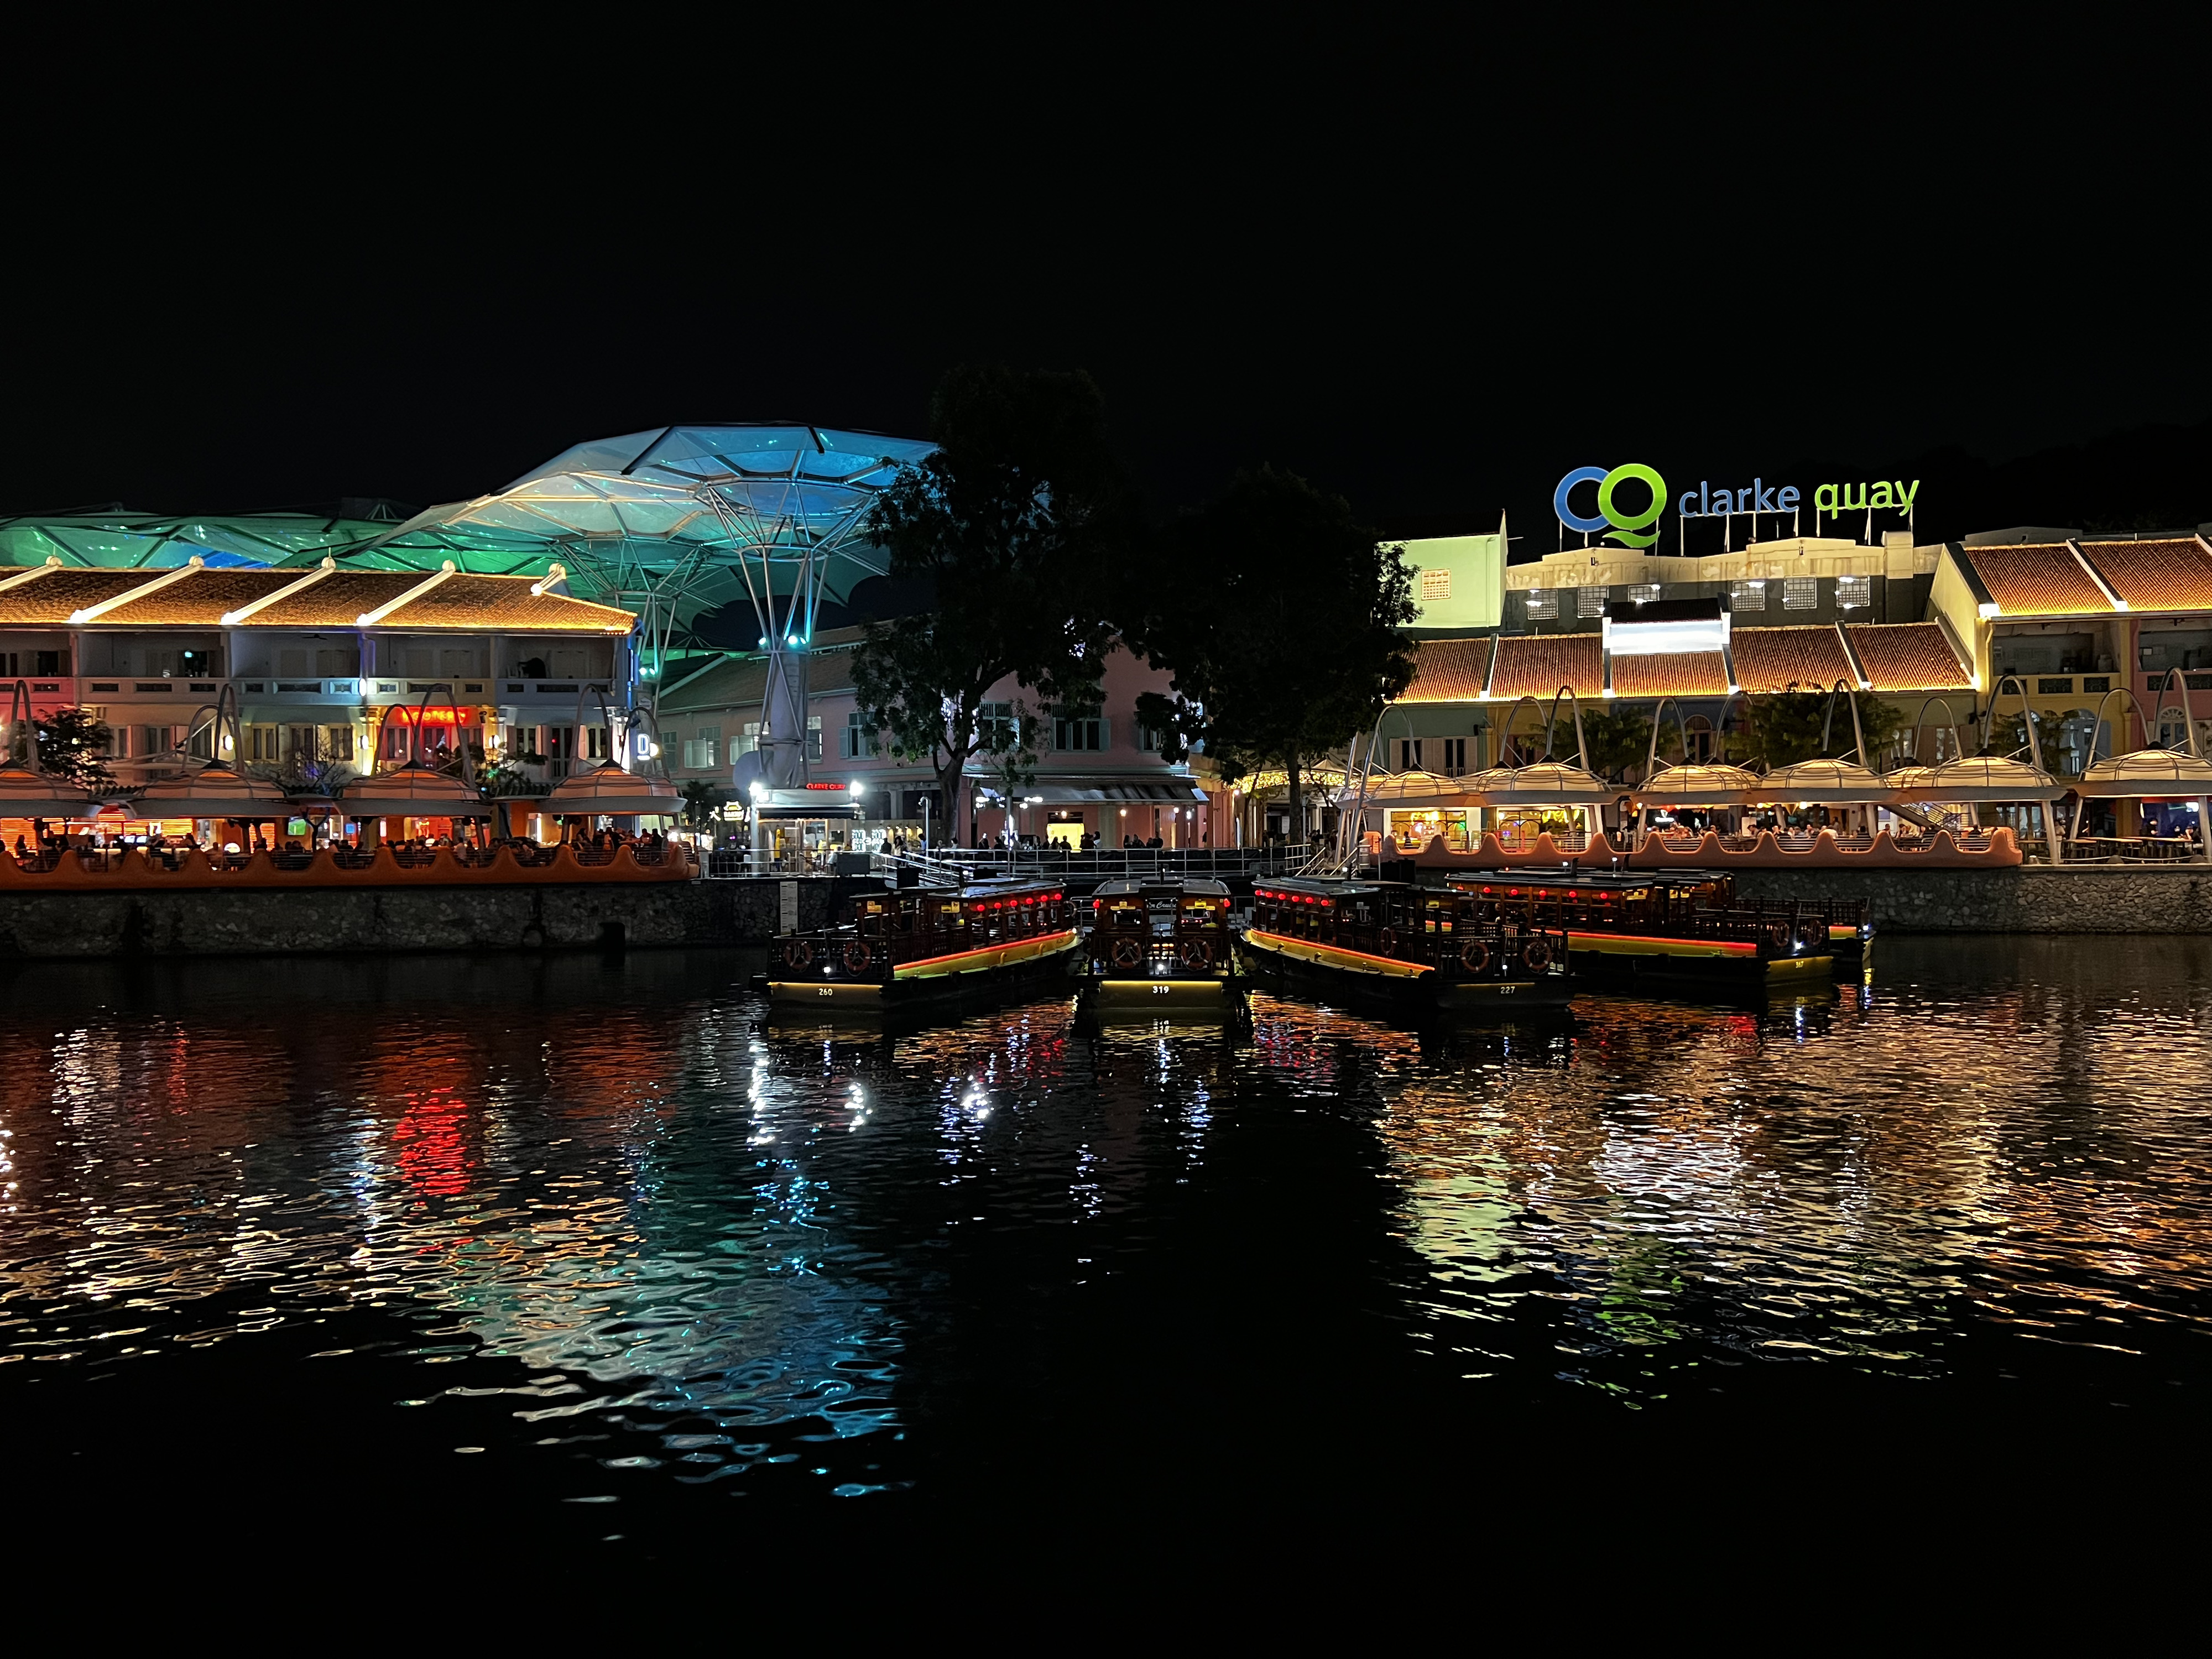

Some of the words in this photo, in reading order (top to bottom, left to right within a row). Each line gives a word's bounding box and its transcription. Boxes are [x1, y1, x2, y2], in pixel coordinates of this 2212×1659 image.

[1679, 478, 1800, 518] clarke
[1814, 479, 1920, 519] quay
[819, 988, 833, 996] 260
[1152, 985, 1169, 994] 319
[1500, 986, 1515, 994] 227
